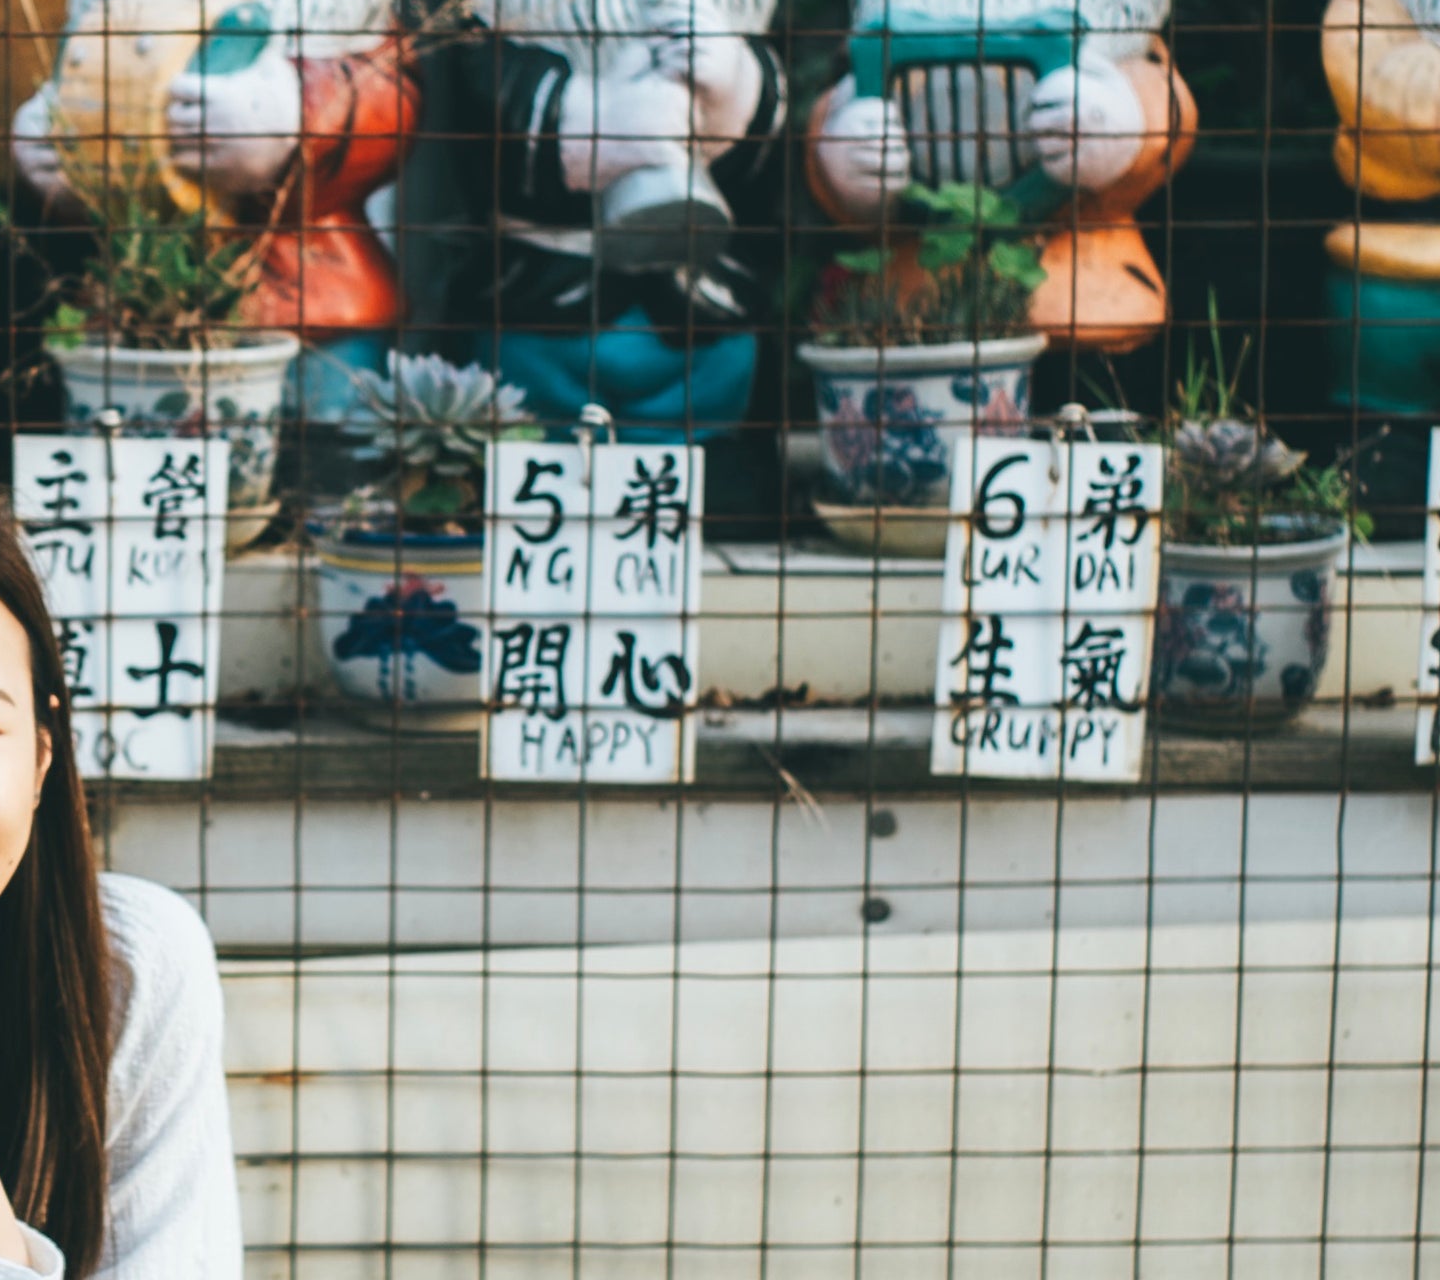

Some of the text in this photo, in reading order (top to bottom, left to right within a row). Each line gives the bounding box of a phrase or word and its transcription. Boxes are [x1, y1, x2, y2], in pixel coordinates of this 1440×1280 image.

[25, 450, 207, 540] 主管
[514, 453, 688, 549] 5弟
[974, 453, 1148, 549] 6弟
[1074, 551, 1135, 593] DAI
[492, 622, 692, 720] 開心
[949, 613, 1142, 714] 生氣
[521, 723, 658, 774] HAPPY
[950, 706, 1119, 766] GRUMPY
